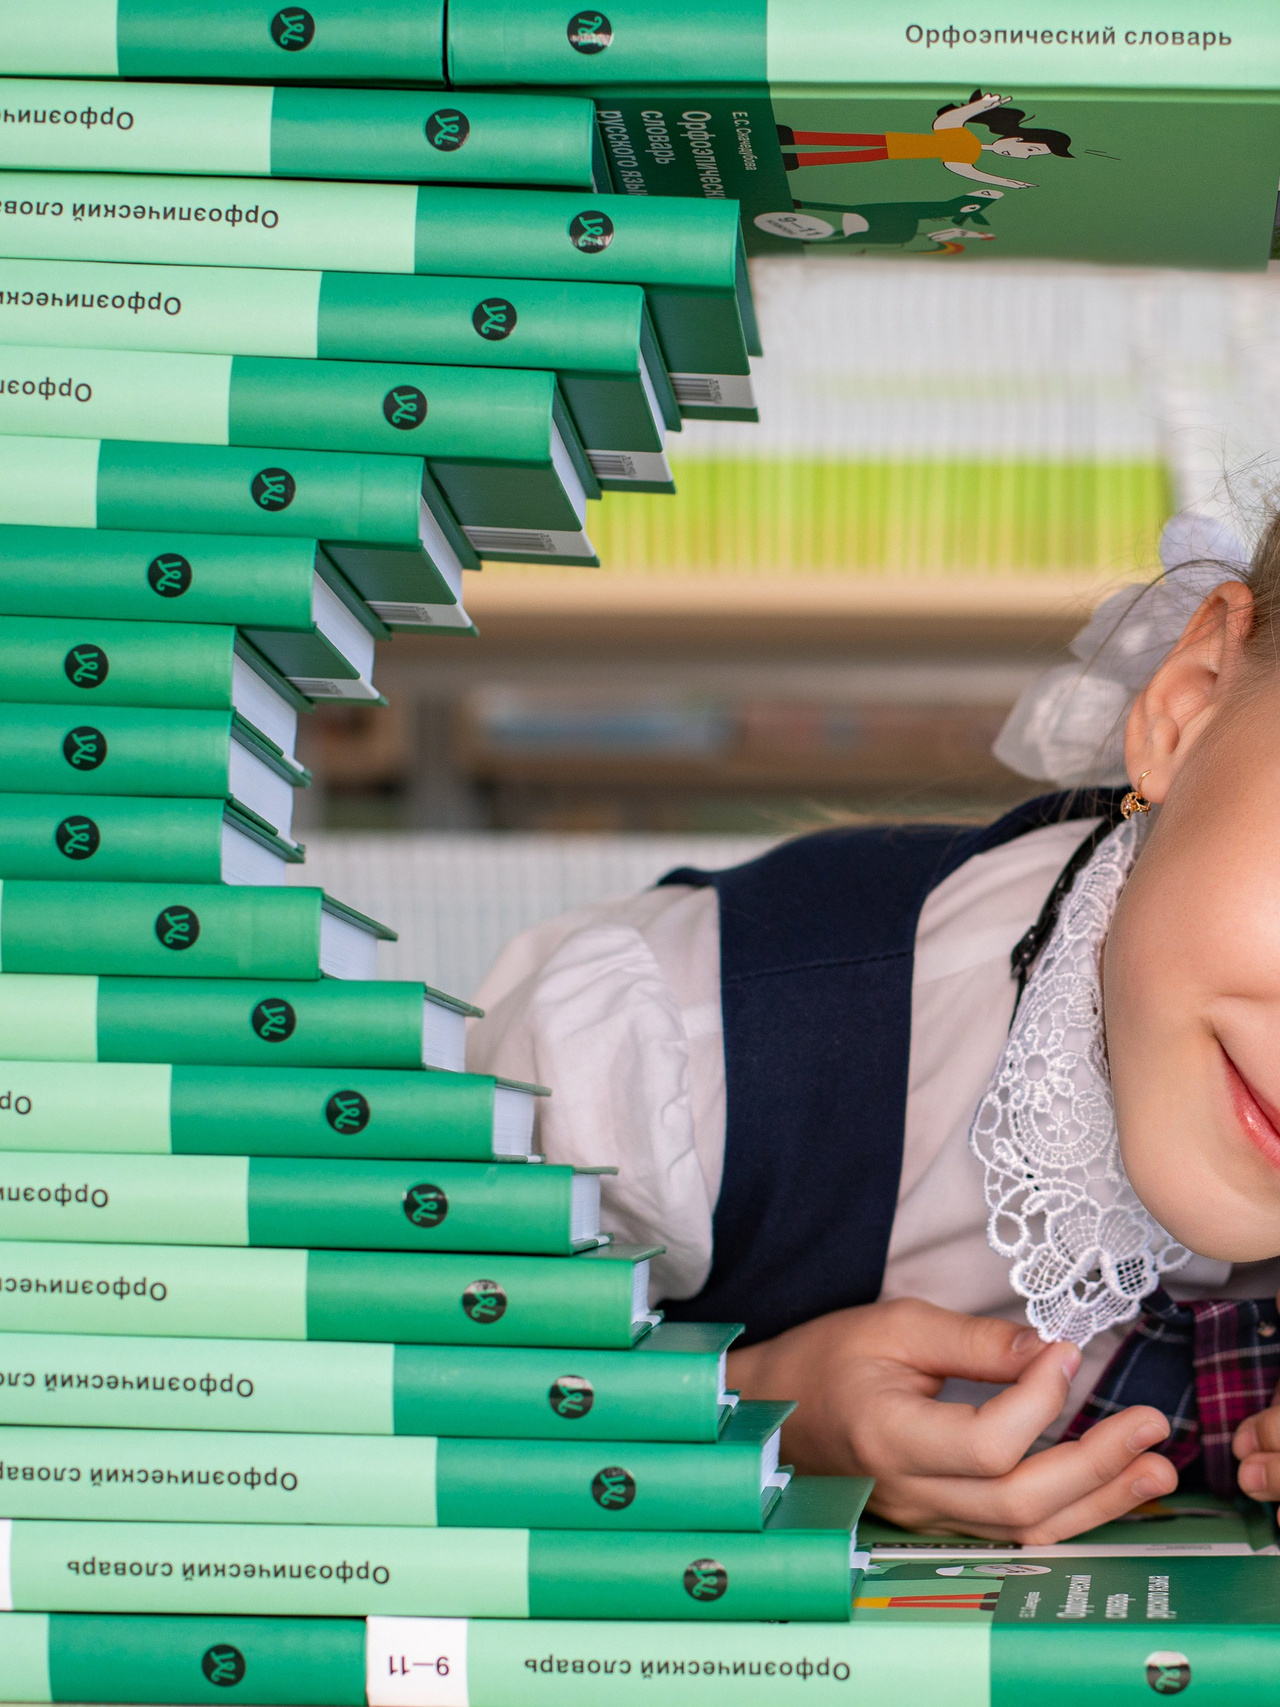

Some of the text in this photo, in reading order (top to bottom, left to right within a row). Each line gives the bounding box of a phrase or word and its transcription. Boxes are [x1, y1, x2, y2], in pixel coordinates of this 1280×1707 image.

[905, 23, 1233, 52] Орфоэпический словарь
[0, 105, 135, 131] Орфоэпич
[597, 110, 638, 168] русского
[641, 110, 676, 165] словарь
[0, 200, 280, 229] Орфоэпический слов
[0, 1275, 168, 1302] Орфоэпичес
[44, 1372, 255, 1399] Орфоэпический
[89, 1465, 299, 1492] Орфоэпический
[66, 1555, 391, 1586] Орфоэпический словарь
[523, 1653, 852, 1682] Орфоэпический словарь
